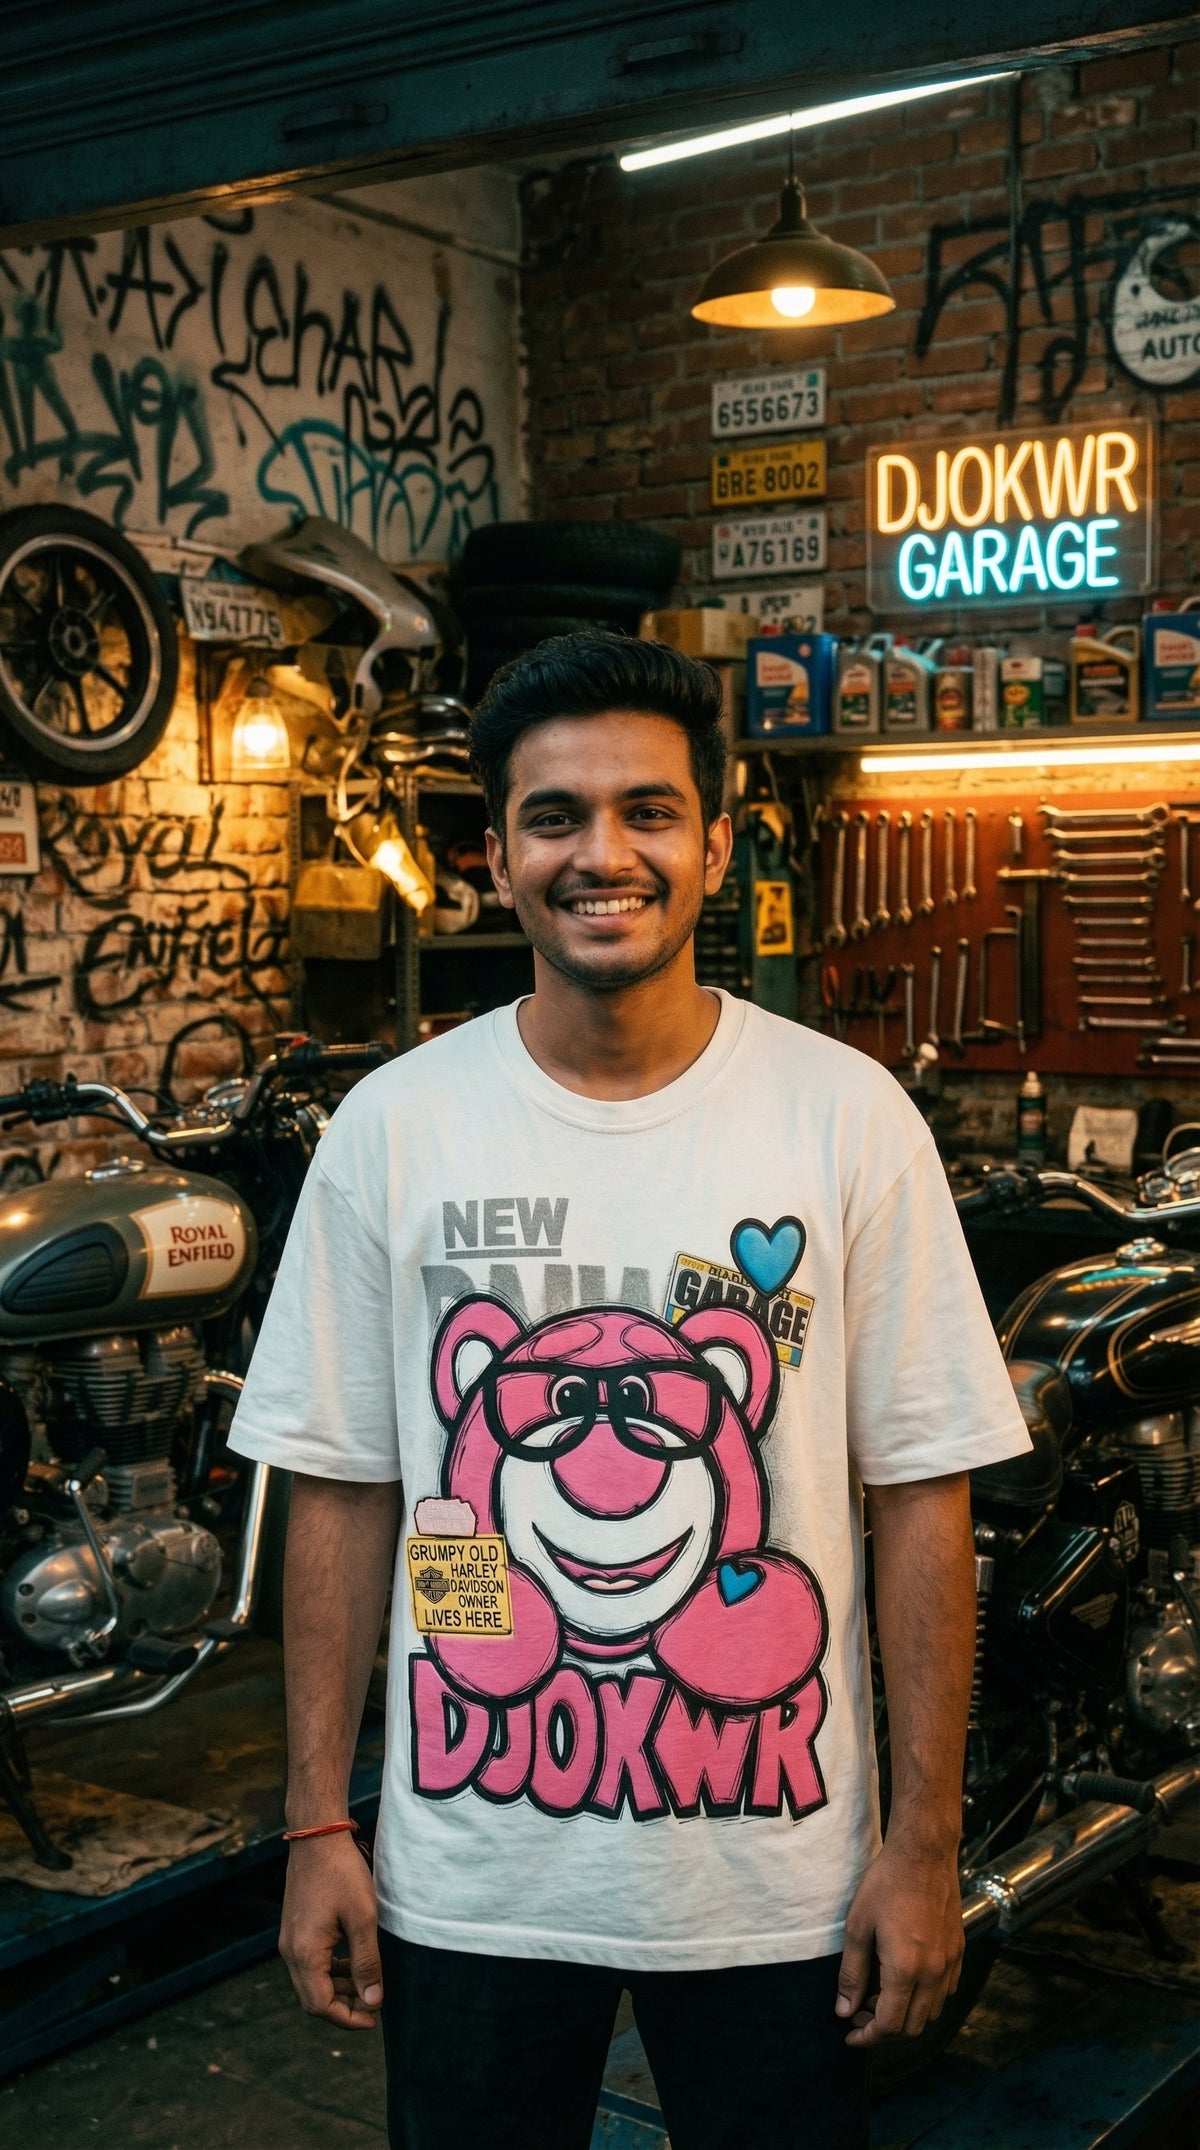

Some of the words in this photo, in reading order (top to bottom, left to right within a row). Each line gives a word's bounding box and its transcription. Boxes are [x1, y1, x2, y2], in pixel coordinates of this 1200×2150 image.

[718, 390, 819, 428] 6556673
[763, 461, 819, 492] 8002
[877, 431, 1139, 533] DJOKWR
[732, 535, 820, 568] A76169
[898, 518, 1120, 601] GARAGE
[170, 1224, 227, 1244] ROYAL
[442, 1197, 569, 1249] NEW
[168, 1243, 235, 1267] ENFIELD
[409, 1544, 464, 1561] GRUMPY
[469, 1545, 498, 1561] OLD
[451, 1563, 498, 1578] HARLEY
[450, 1580, 504, 1593] DAVIDSON
[458, 1595, 499, 1609] OWNER
[424, 1609, 462, 1627] LIVES
[465, 1610, 503, 1628] HERE
[408, 1652, 829, 1822] DJOKWR
